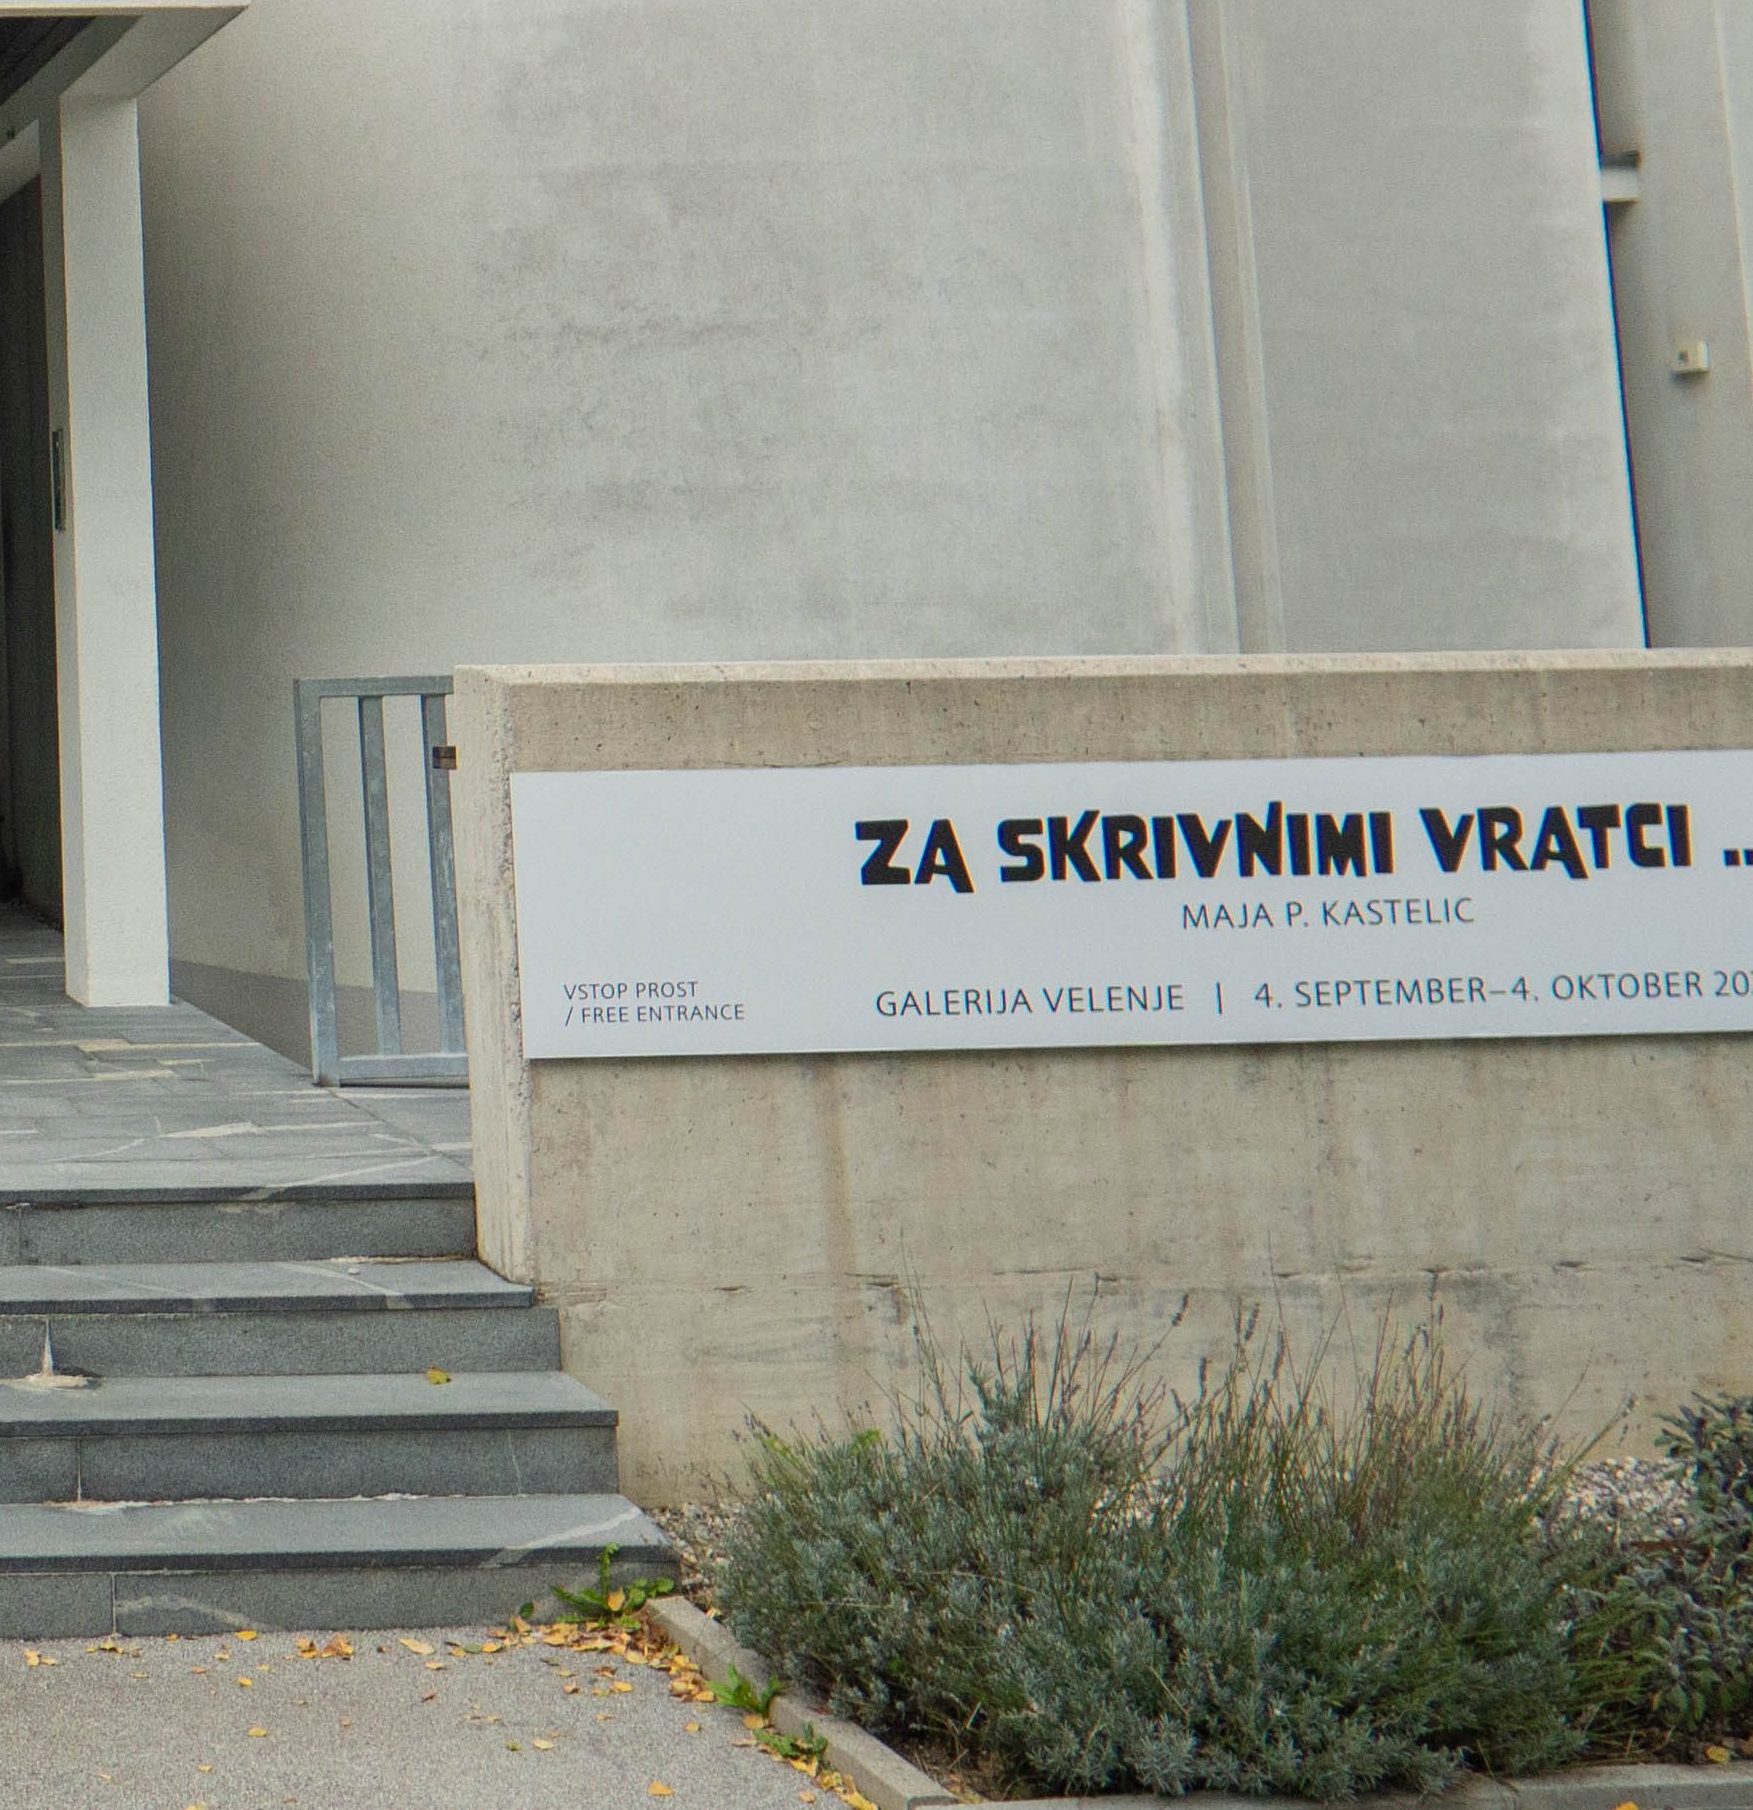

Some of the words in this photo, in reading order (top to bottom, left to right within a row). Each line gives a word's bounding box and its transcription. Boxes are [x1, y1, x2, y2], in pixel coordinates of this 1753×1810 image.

[855, 819, 974, 894] ZA
[997, 801, 1393, 883] SKRIVNIMI
[1419, 803, 1692, 880] VRATCI
[1182, 902, 1274, 929] MAJA
[1286, 900, 1310, 928] P.
[1322, 896, 1474, 926] KASTELIC
[563, 982, 628, 1001] VSTOP
[635, 981, 699, 999] PROST
[876, 988, 1033, 1018] GALERIJA
[1042, 984, 1185, 1013] VELENJE
[1254, 981, 1284, 1009] 4.
[1551, 970, 1704, 1001] OKTOBER
[1713, 969, 1753, 998] 20
[581, 1006, 630, 1023] FREE
[636, 1003, 745, 1022] ENTRANCE
